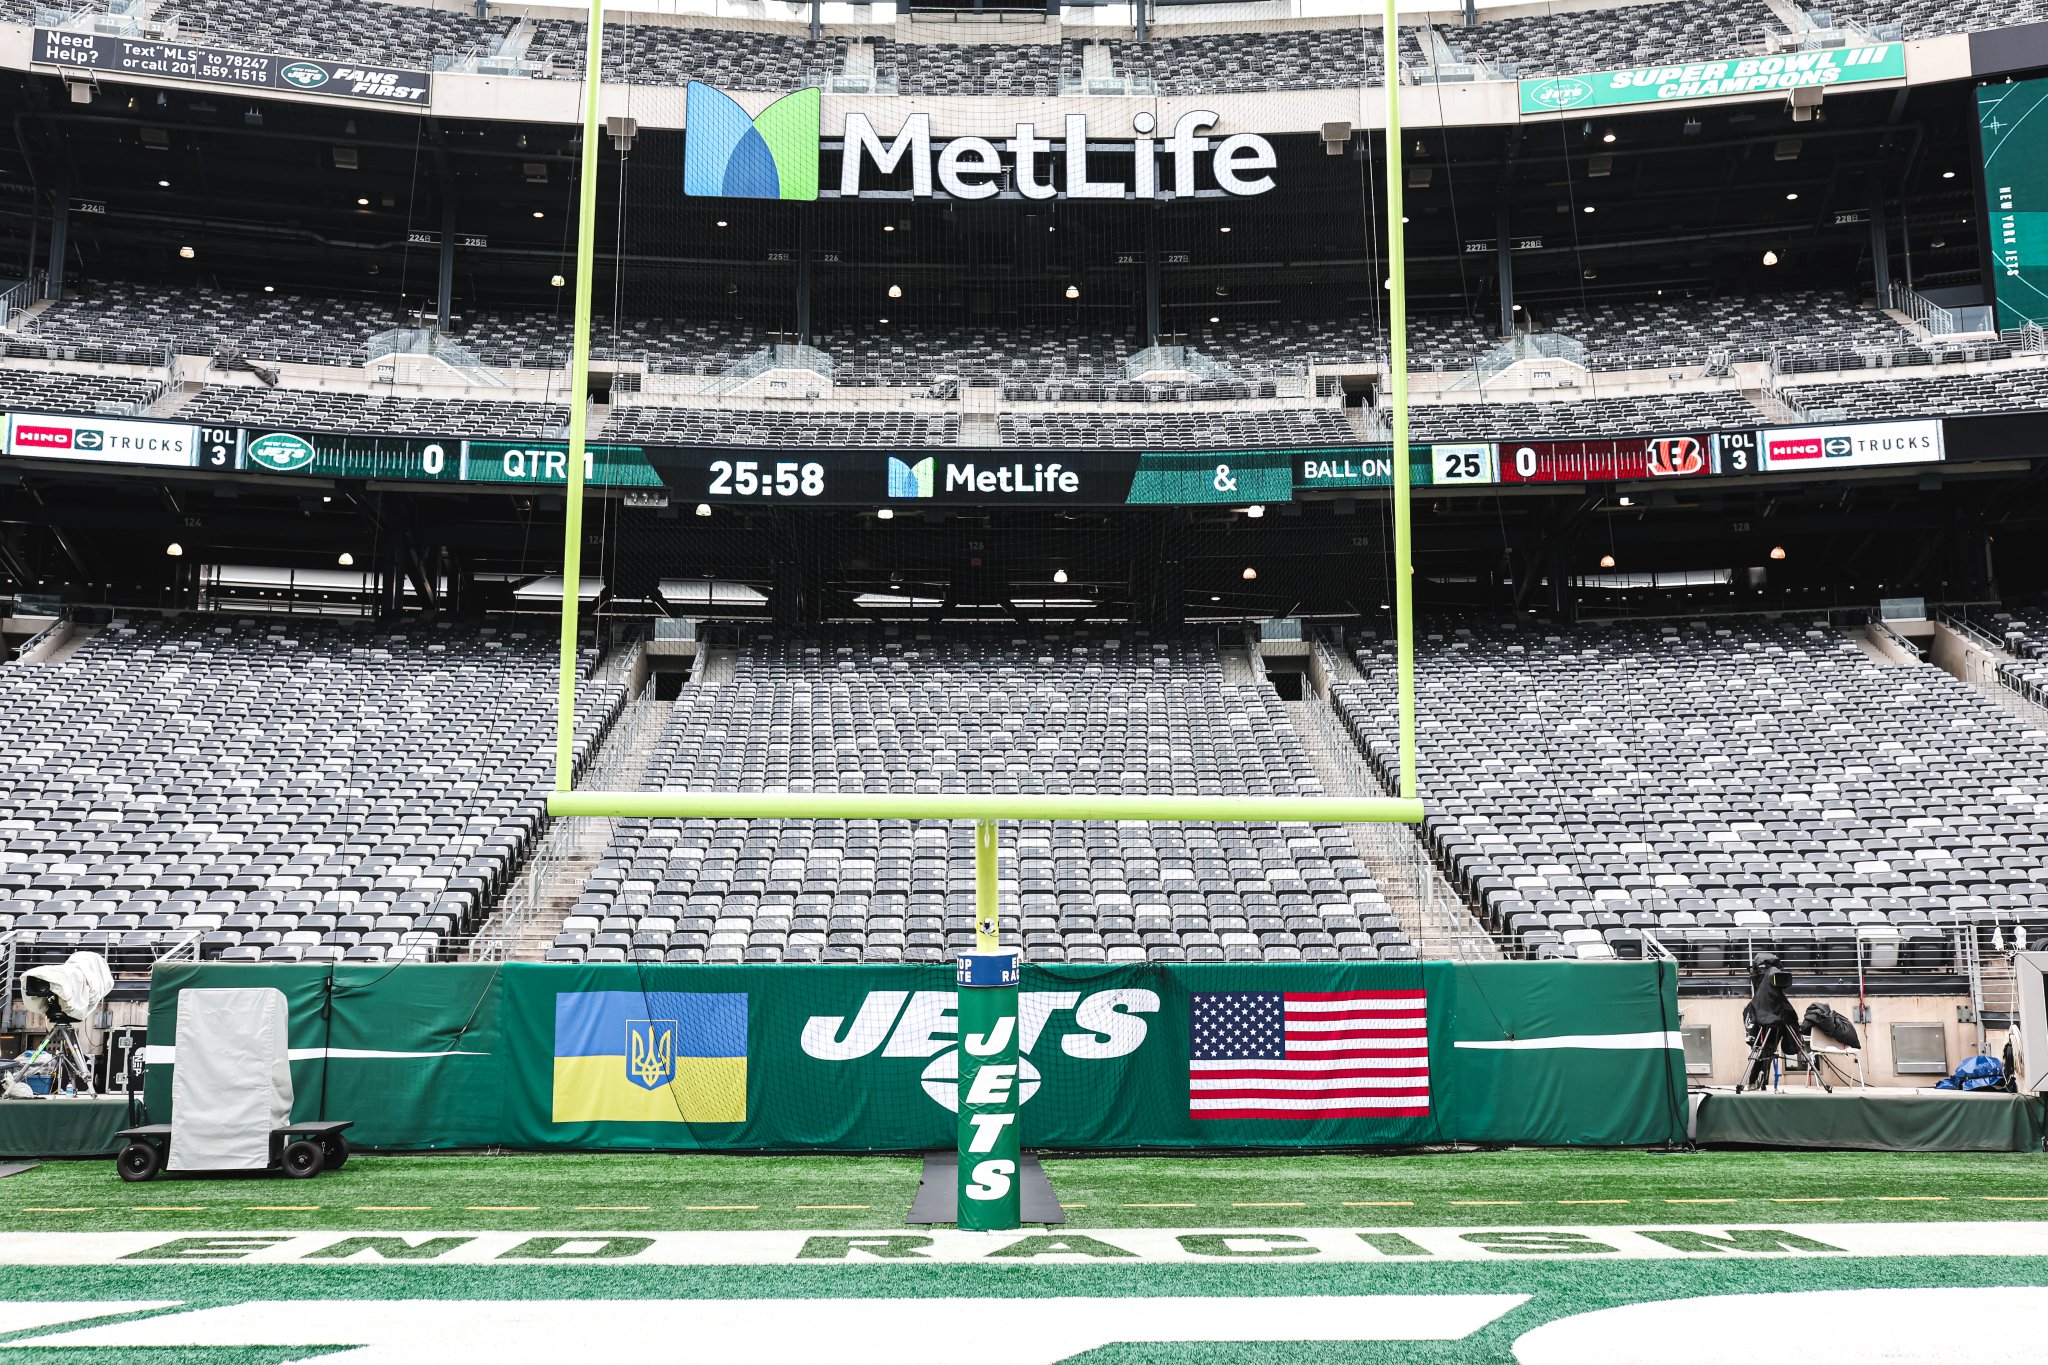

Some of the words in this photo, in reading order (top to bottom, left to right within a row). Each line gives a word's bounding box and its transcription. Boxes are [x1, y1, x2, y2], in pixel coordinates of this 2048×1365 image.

[46, 31, 94, 49] Need
[46, 45, 99, 64] Help?
[123, 43, 154, 58] Text
[208, 54, 222, 64] to
[225, 54, 269, 69] 78247
[123, 58, 141, 68] or
[141, 59, 168, 72] call
[171, 63, 267, 82] 201.559.1515
[332, 68, 399, 85] FANS
[1609, 62, 1729, 89] SUPER
[1733, 52, 1837, 77] BOWL
[1844, 46, 1889, 66] III
[351, 82, 426, 99] FIRST
[1657, 68, 1842, 98] CHAMPIONS
[840, 109, 1278, 200] MetLife
[1999, 186, 2013, 210] NEW
[2001, 215, 2016, 244] YORK
[824, 254, 840, 262] 226
[2004, 250, 2019, 276] JETS
[19, 431, 69, 444] HINO
[109, 436, 183, 452] TRUCKS
[201, 428, 235, 444] TOL
[1720, 433, 1755, 449] TOL
[1773, 444, 1820, 456] HINO
[1857, 436, 1931, 452] TRUCKS
[211, 445, 227, 465] 3
[257, 447, 307, 459] JETS
[422, 443, 445, 475] 0
[503, 449, 567, 479] QTR
[582, 452, 594, 480] 1
[1515, 446, 1537, 477] 0
[1732, 450, 1748, 470] 3
[1304, 460, 1358, 480] BALL
[1362, 458, 1392, 478] ON
[1445, 453, 1481, 478] 25
[708, 460, 825, 497] 25:58
[946, 463, 1080, 493] MetLife
[1213, 464, 1238, 492] &
[183, 517, 202, 527] 124
[800, 987, 1161, 1061] JETS
[963, 1016, 1017, 1201] JETS
[113, 1235, 658, 1260] END
[795, 1228, 1850, 1260] RACISM
